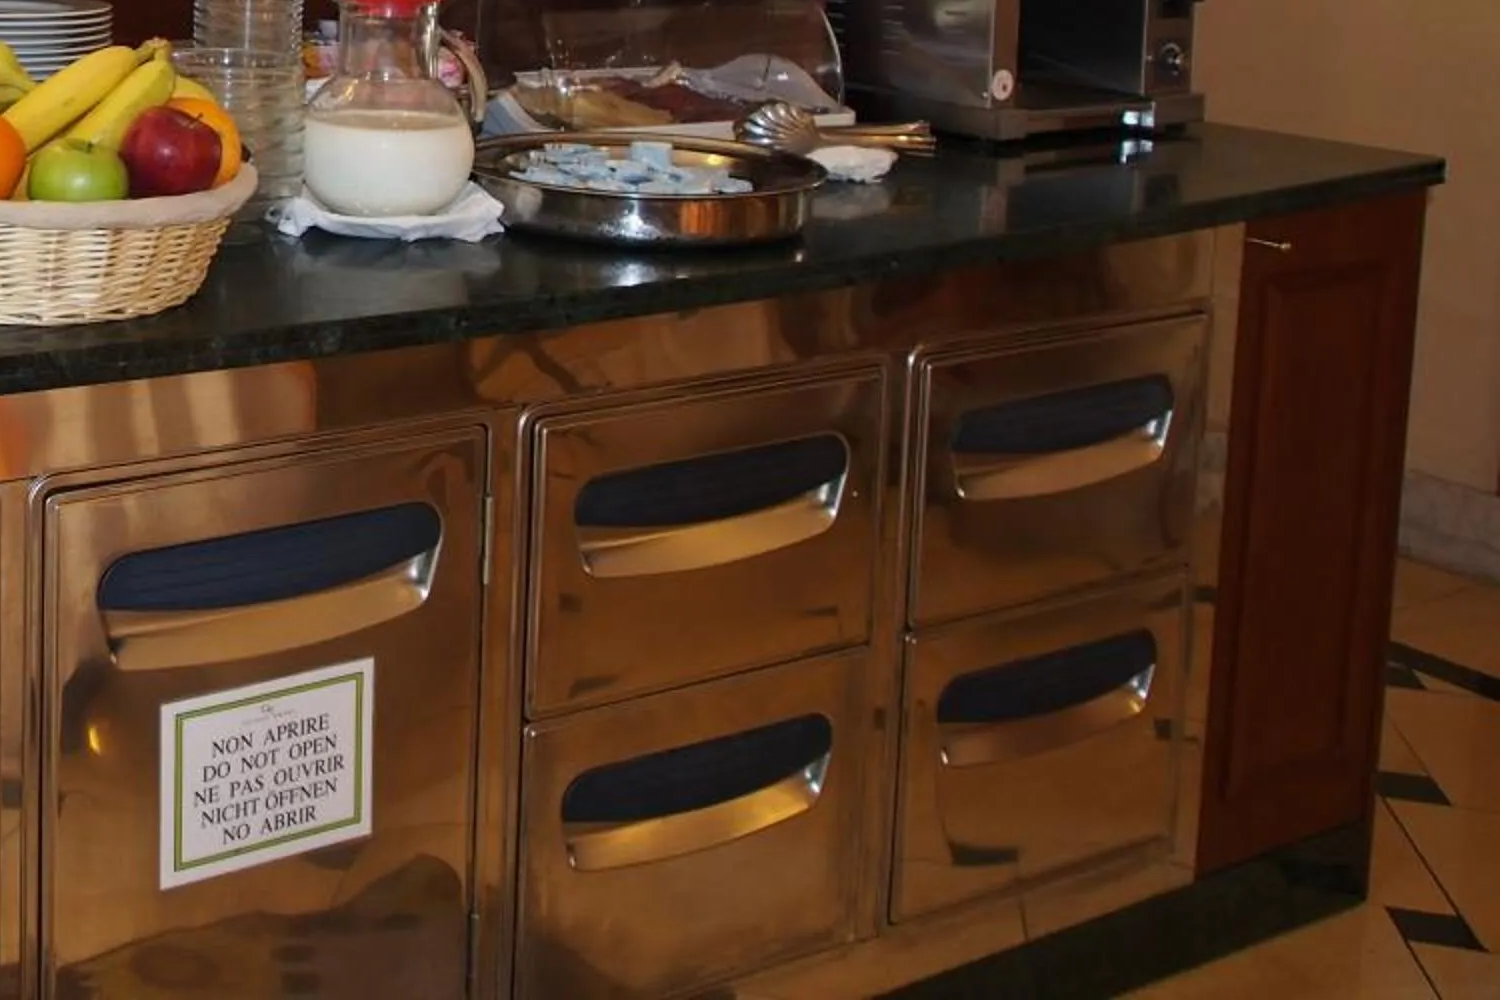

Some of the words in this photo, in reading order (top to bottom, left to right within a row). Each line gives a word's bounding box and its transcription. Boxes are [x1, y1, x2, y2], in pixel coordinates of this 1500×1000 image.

[203, 761, 231, 783] DO
[241, 747, 280, 774] NOT
[288, 733, 337, 760] OPEN
[211, 732, 253, 758] NON
[263, 712, 330, 746] APRIRE
[194, 785, 220, 808] NE
[229, 775, 265, 799] PAS
[273, 753, 344, 786] OUVRIR
[200, 797, 261, 829] NICHT
[222, 822, 251, 845] NO
[260, 804, 317, 836] ABRIR
